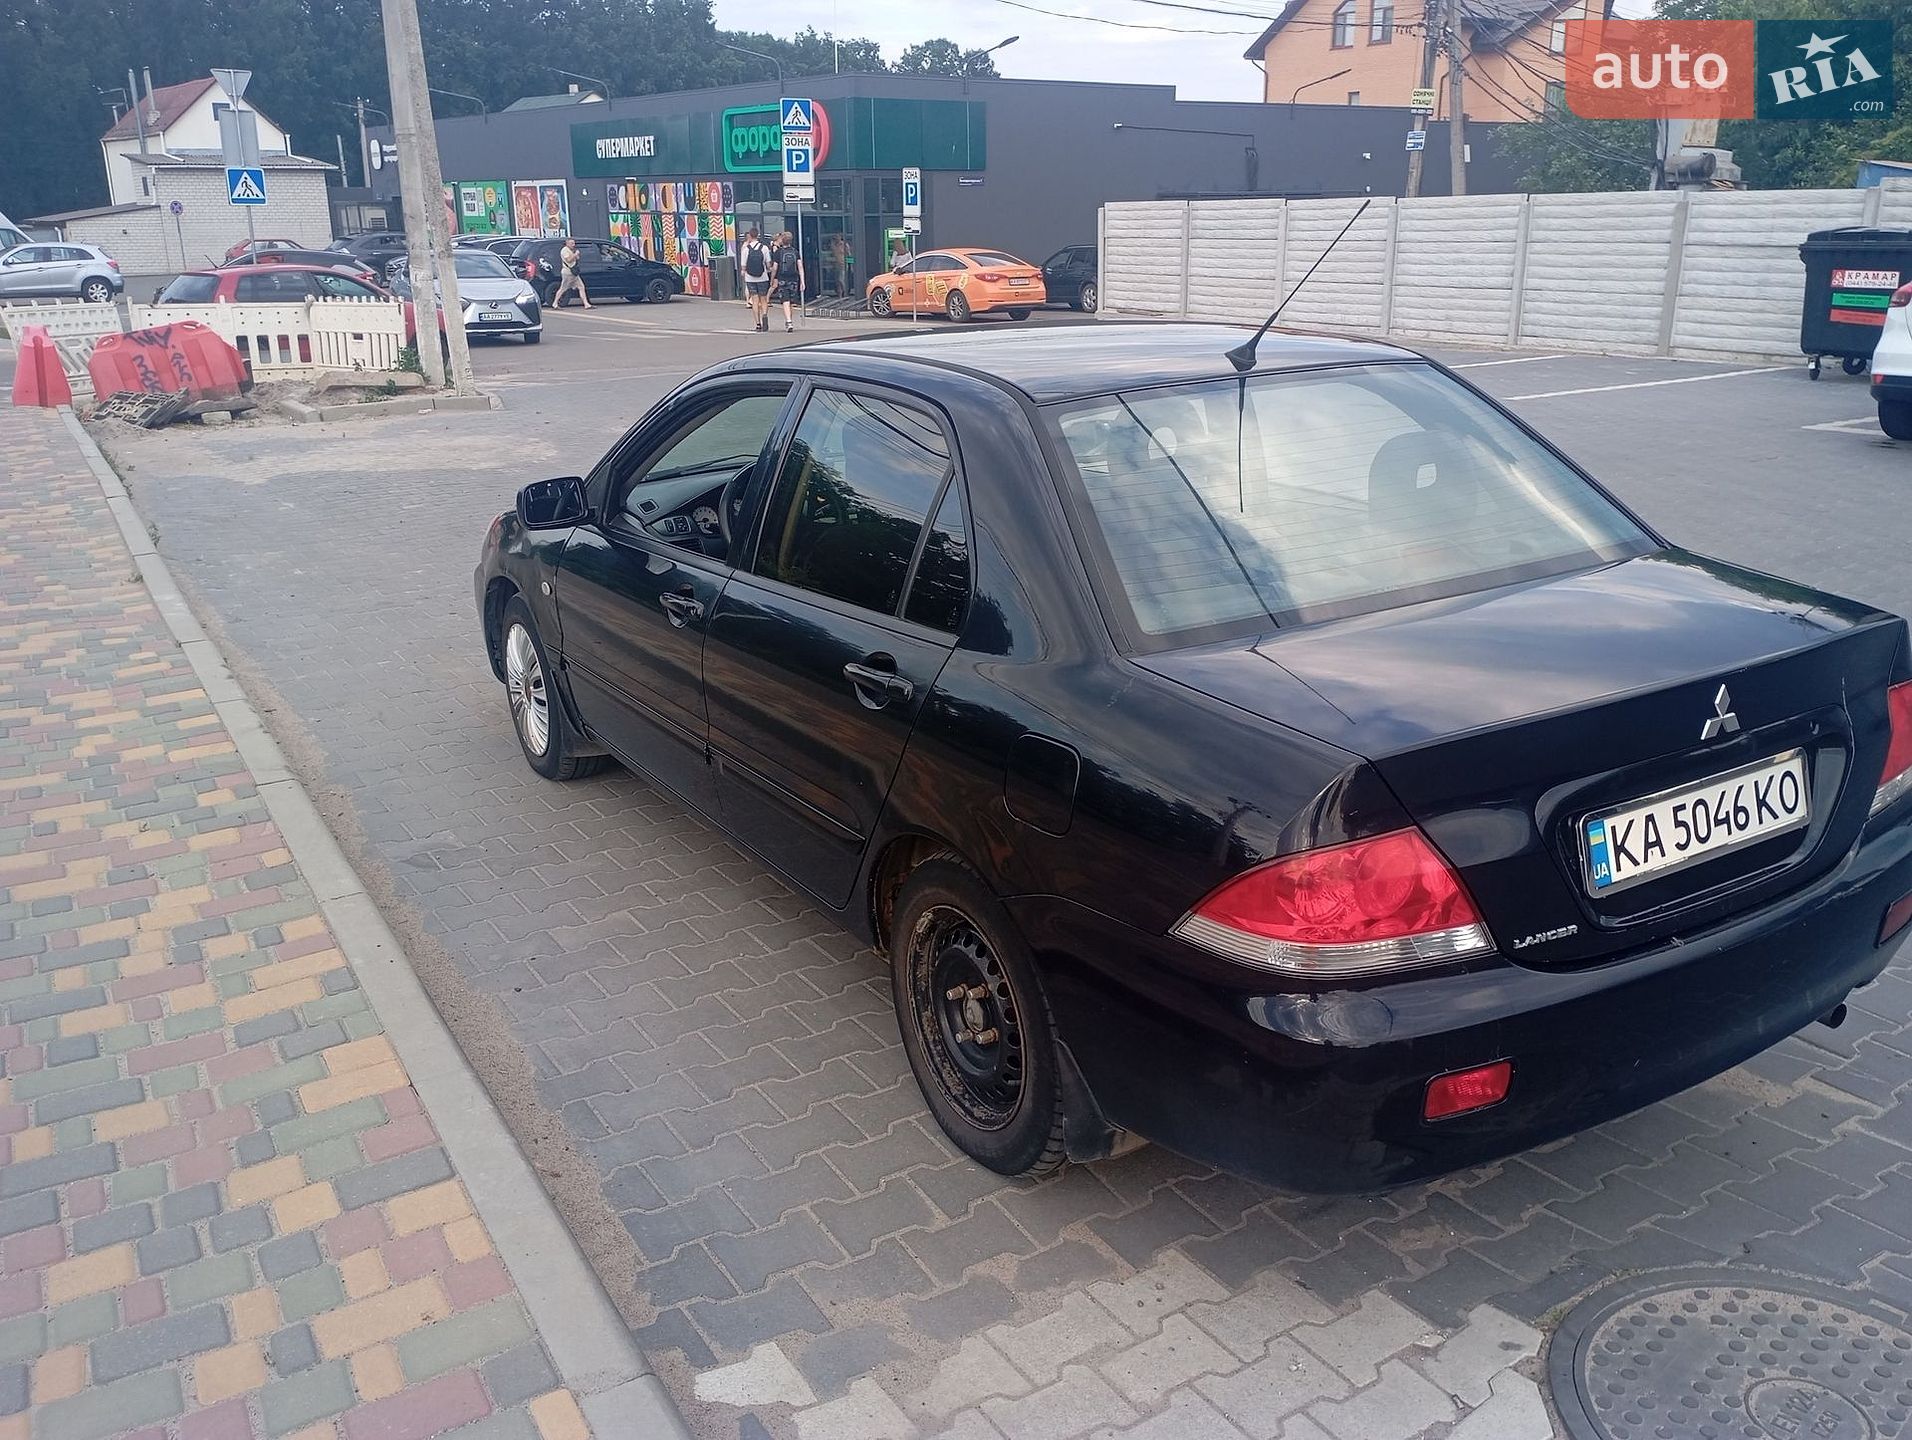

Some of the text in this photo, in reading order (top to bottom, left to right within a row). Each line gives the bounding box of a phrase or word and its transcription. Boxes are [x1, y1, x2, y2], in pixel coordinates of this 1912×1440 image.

[596, 135, 655, 159] СУПЕРМАРКЕТ
[731, 124, 781, 159] фора
[784, 137, 811, 147] ЗОНА
[1847, 271, 1897, 281] КРАМАР
[1610, 770, 1799, 872] KA 5046 KO
[1593, 862, 1609, 880] UA
[1513, 924, 1578, 949] LANCER
